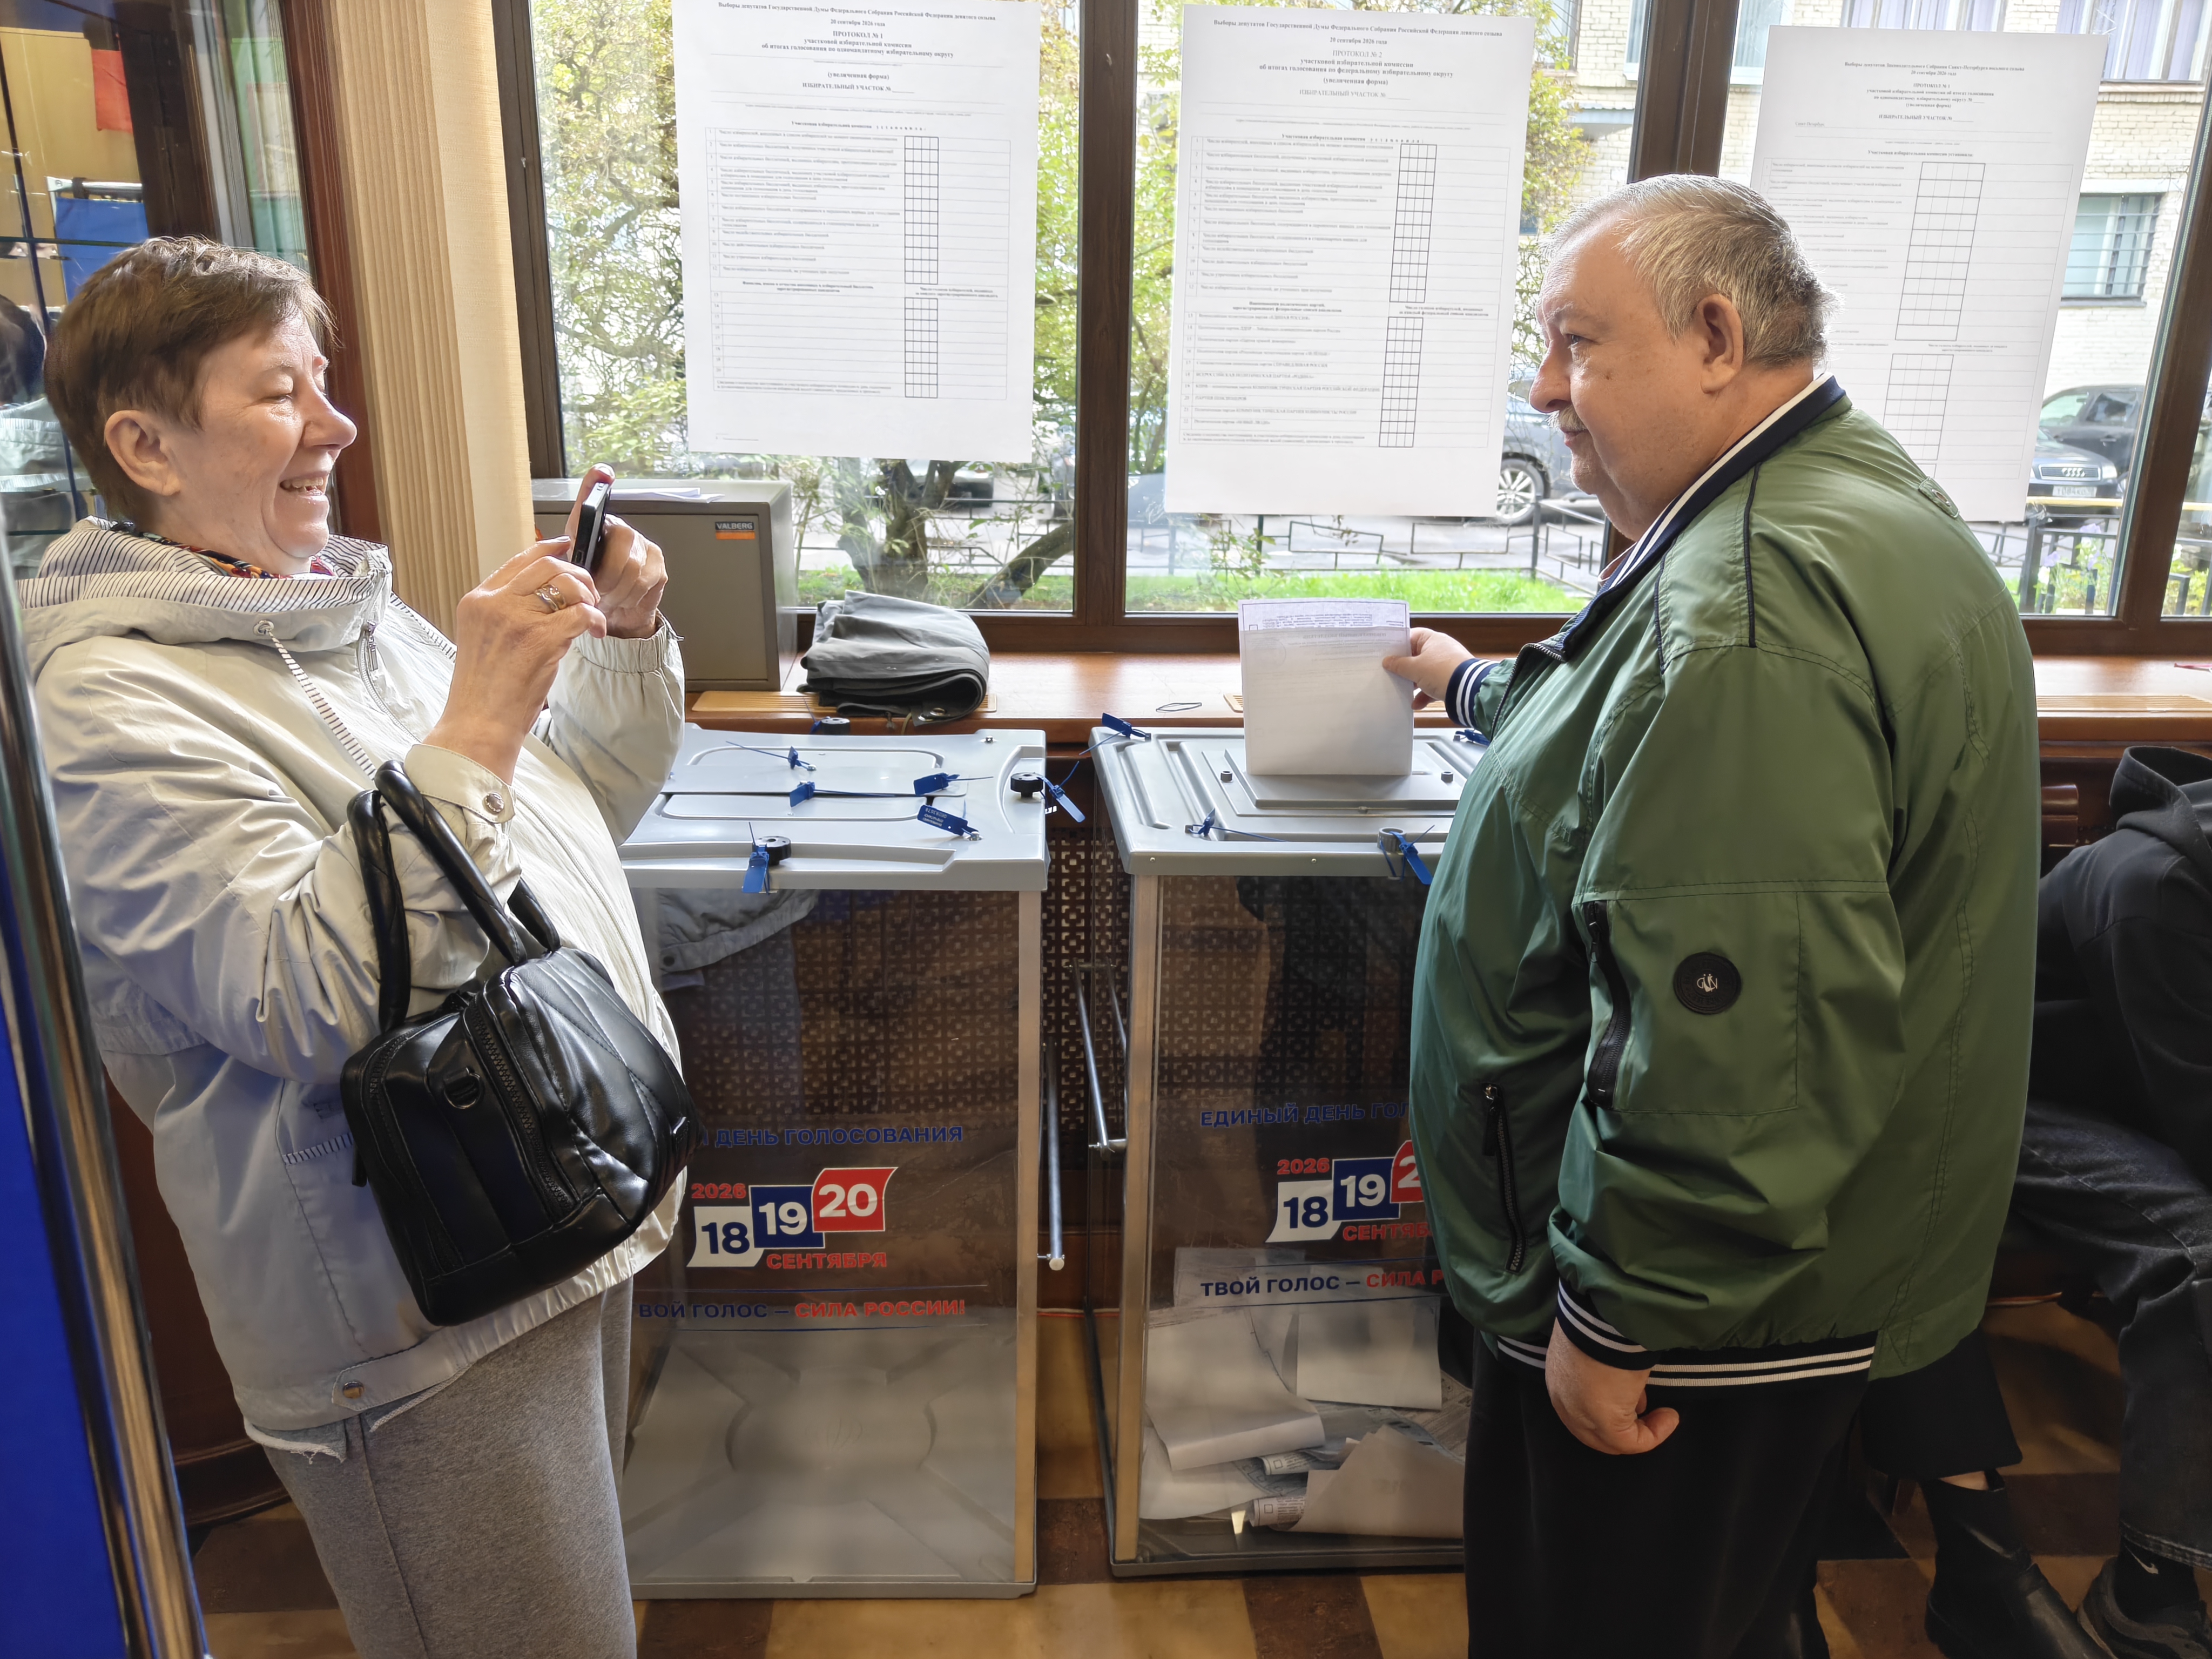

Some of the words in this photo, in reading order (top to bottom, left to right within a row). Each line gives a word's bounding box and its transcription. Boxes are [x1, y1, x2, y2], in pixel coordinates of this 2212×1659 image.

[1201, 1103, 1298, 1128] ЕДИНЫЙ
[1304, 1104, 1365, 1124] ДЕНЬ
[715, 1129, 779, 1148] ДЕНЬ
[784, 1126, 963, 1145] ГОЛОСОВАНИЯ
[1277, 1158, 1330, 1175] 2026
[691, 1183, 746, 1199] 2026
[1283, 1196, 1328, 1229] 18
[1340, 1174, 1386, 1208] 19
[1398, 1155, 1422, 1188] 2
[701, 1222, 751, 1255] 18
[759, 1201, 808, 1235] 19
[818, 1183, 878, 1217] 20
[1343, 1222, 1433, 1242] СЕНТЯБ
[766, 1252, 887, 1270] СЕНТЯБРЯ
[1201, 1277, 1259, 1297] ТВОЙ
[1266, 1276, 1340, 1293] ГОЛОС
[1366, 1271, 1426, 1288] СИЛА
[633, 1301, 685, 1318] ВОЙ
[693, 1303, 768, 1318] ГОЛОС
[794, 1302, 858, 1318] СИЛА
[864, 1299, 966, 1317] РОССИИ!
